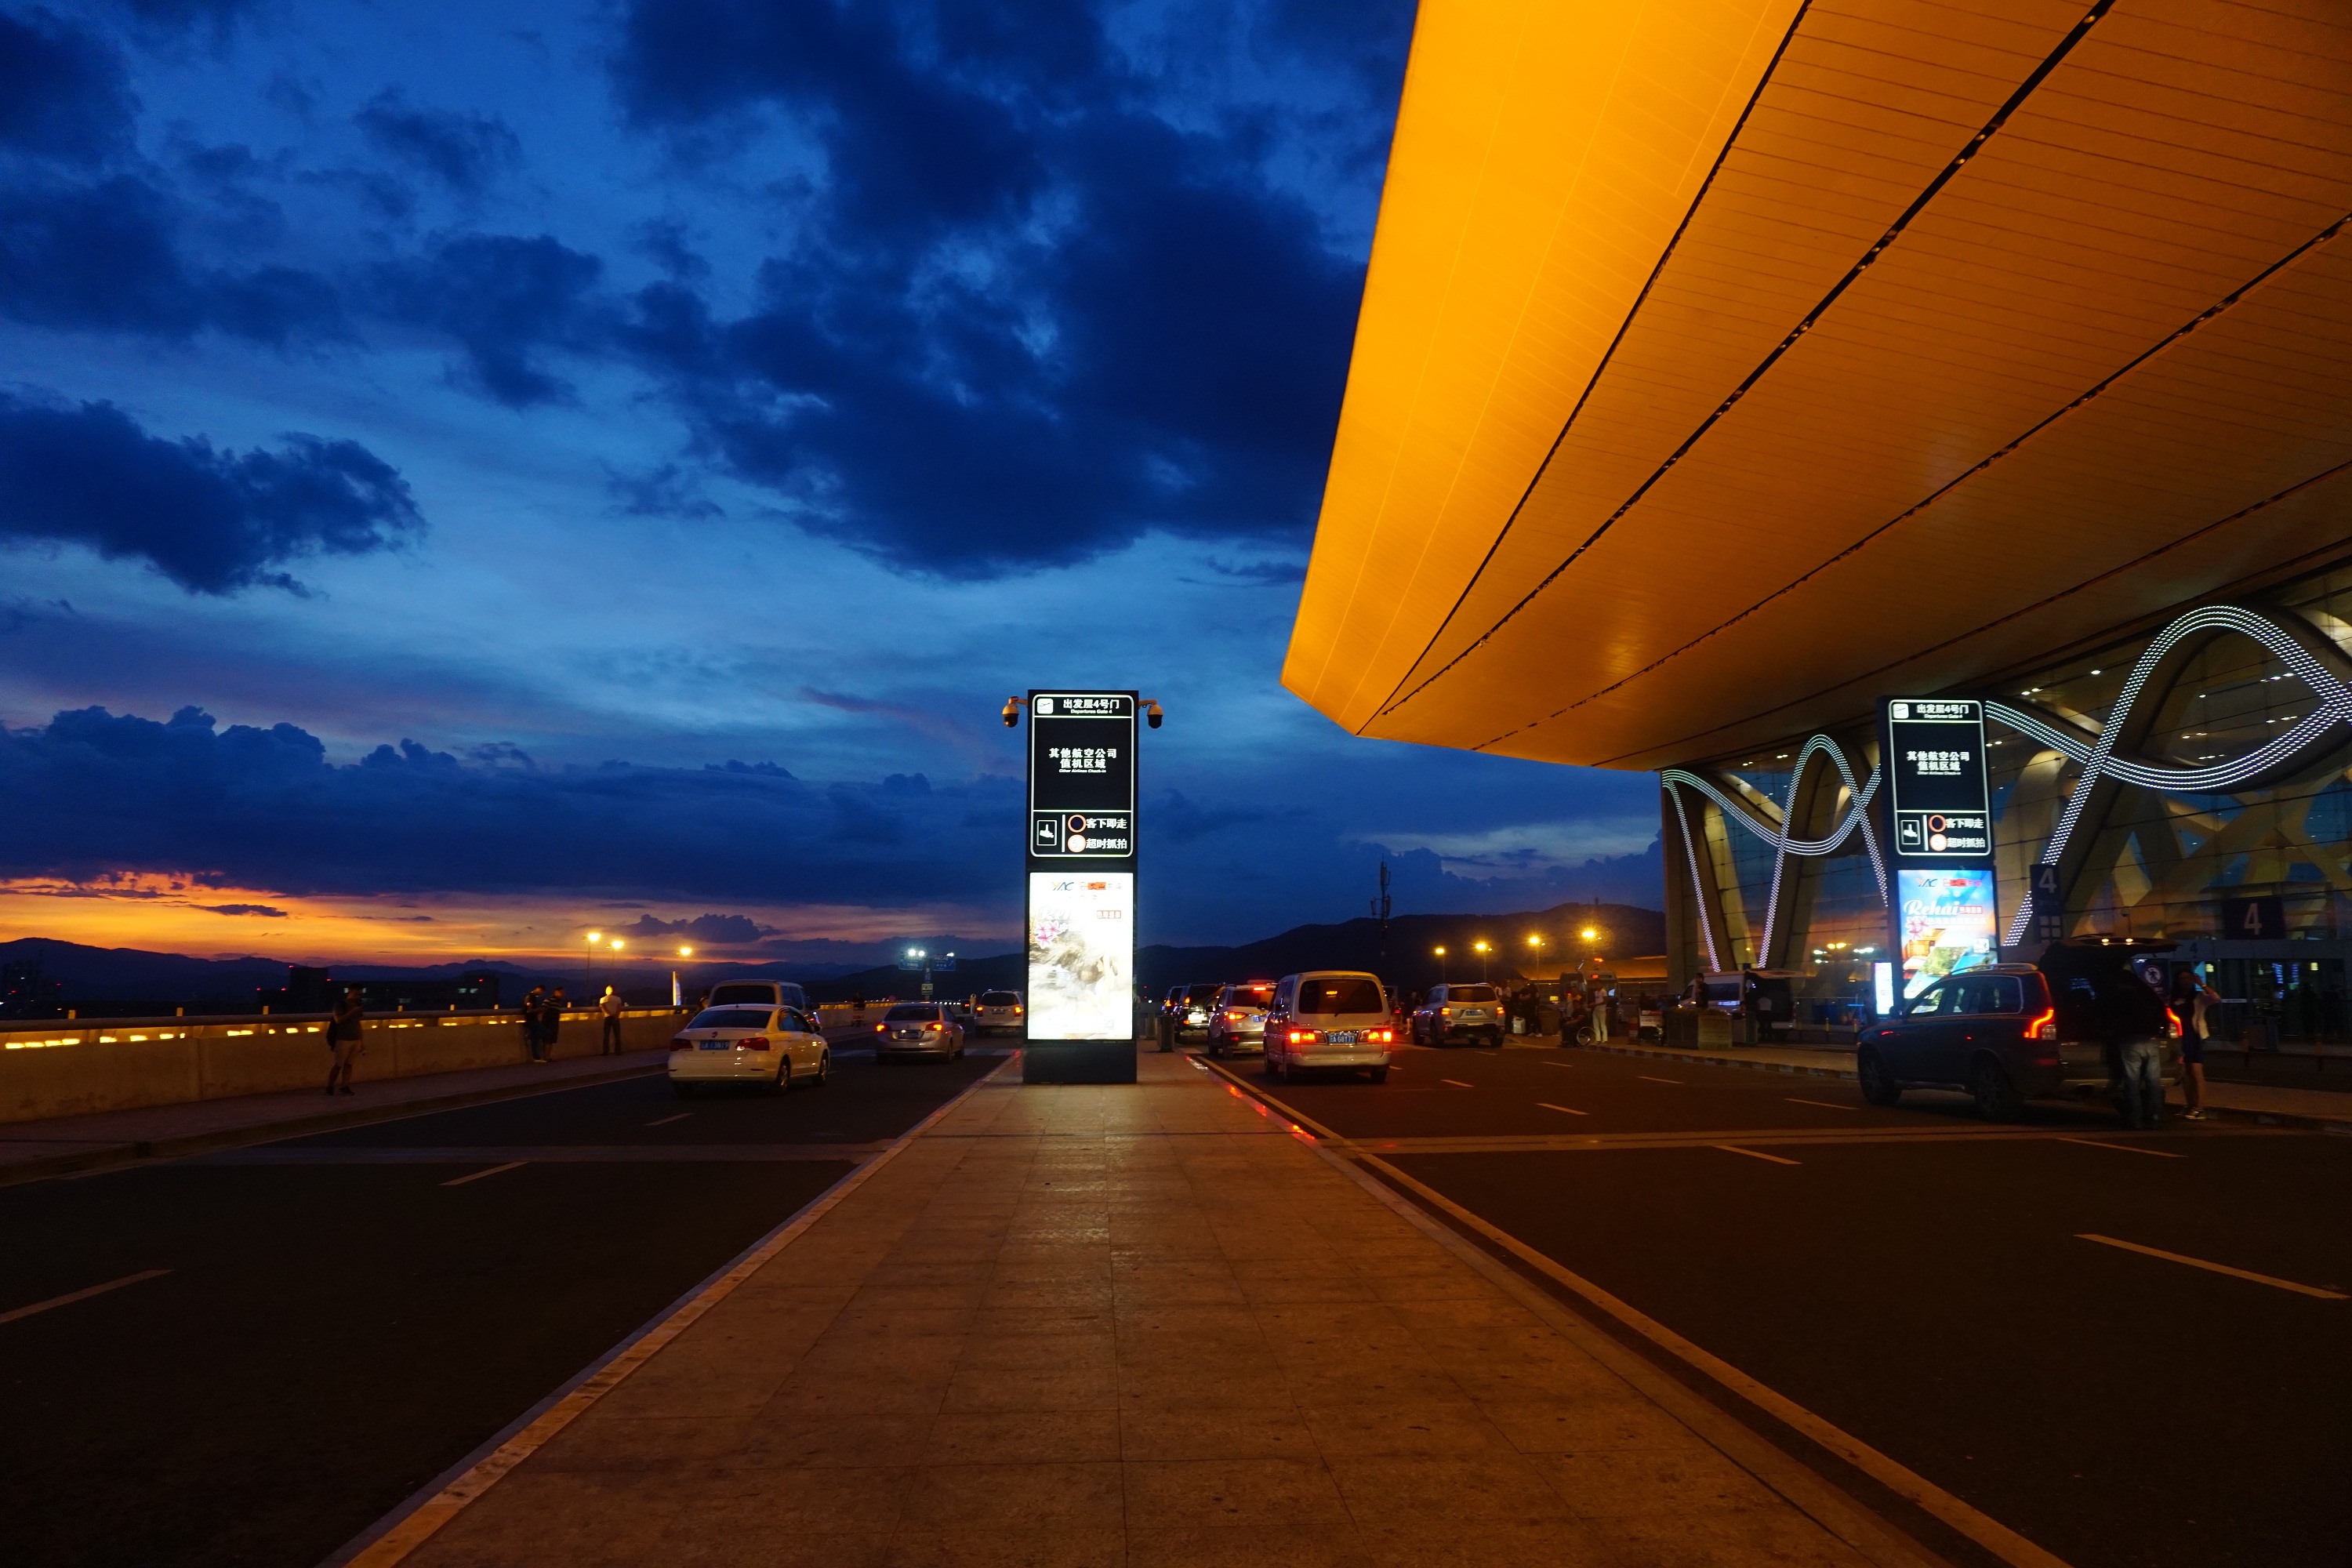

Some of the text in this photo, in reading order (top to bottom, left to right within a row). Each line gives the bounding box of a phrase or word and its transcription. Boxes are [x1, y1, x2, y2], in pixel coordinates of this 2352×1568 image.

[1063, 699, 1120, 709] 出发层4号门
[1916, 704, 1969, 714] 出发层4号门
[1049, 748, 1117, 758] 其他航空公司
[1907, 751, 1970, 761] 其他航空公司
[1060, 758, 1106, 768] 值机区域
[1918, 760, 1961, 771] 值机区域
[1086, 818, 1127, 829] 客下即走
[1946, 818, 1984, 829] 客下即走
[1086, 838, 1127, 849] 超时抓拍
[1947, 837, 1985, 848] 超时抓拍
[2039, 868, 2057, 893] 4
[1903, 899, 1960, 916] Rehai
[2244, 902, 2263, 935] 4
